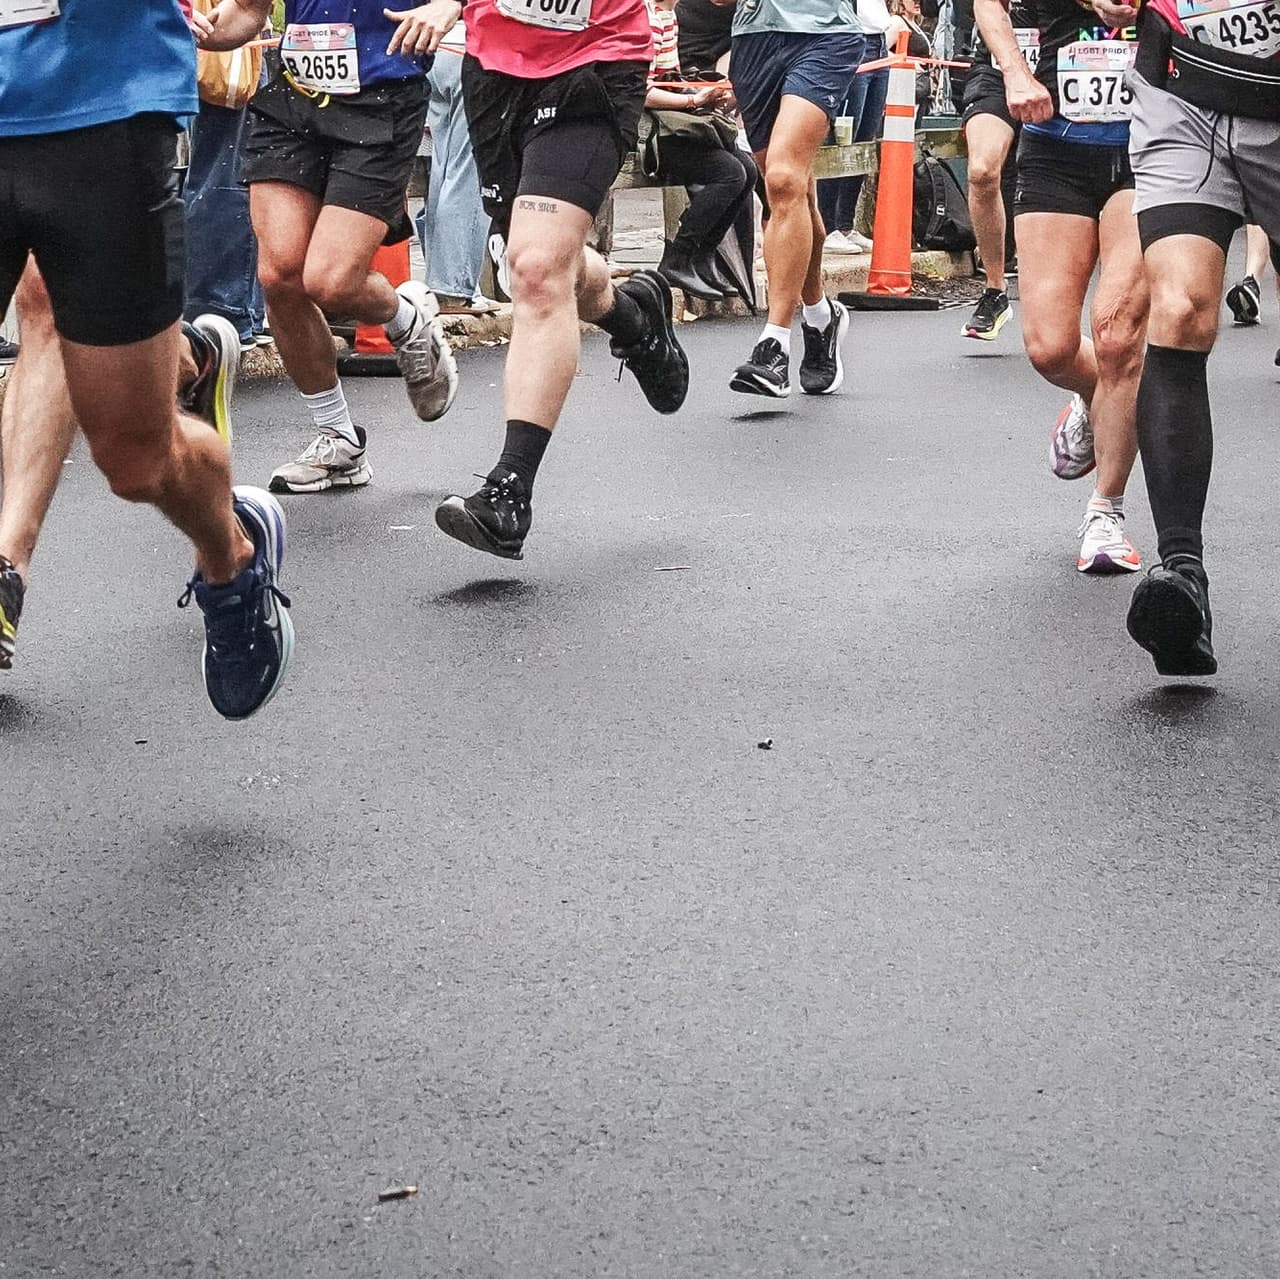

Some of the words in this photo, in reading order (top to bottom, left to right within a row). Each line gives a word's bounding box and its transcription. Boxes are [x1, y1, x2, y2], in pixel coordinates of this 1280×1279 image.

[286, 58, 300, 76] B
[302, 55, 348, 80] 2655
[1064, 79, 1079, 104] C
